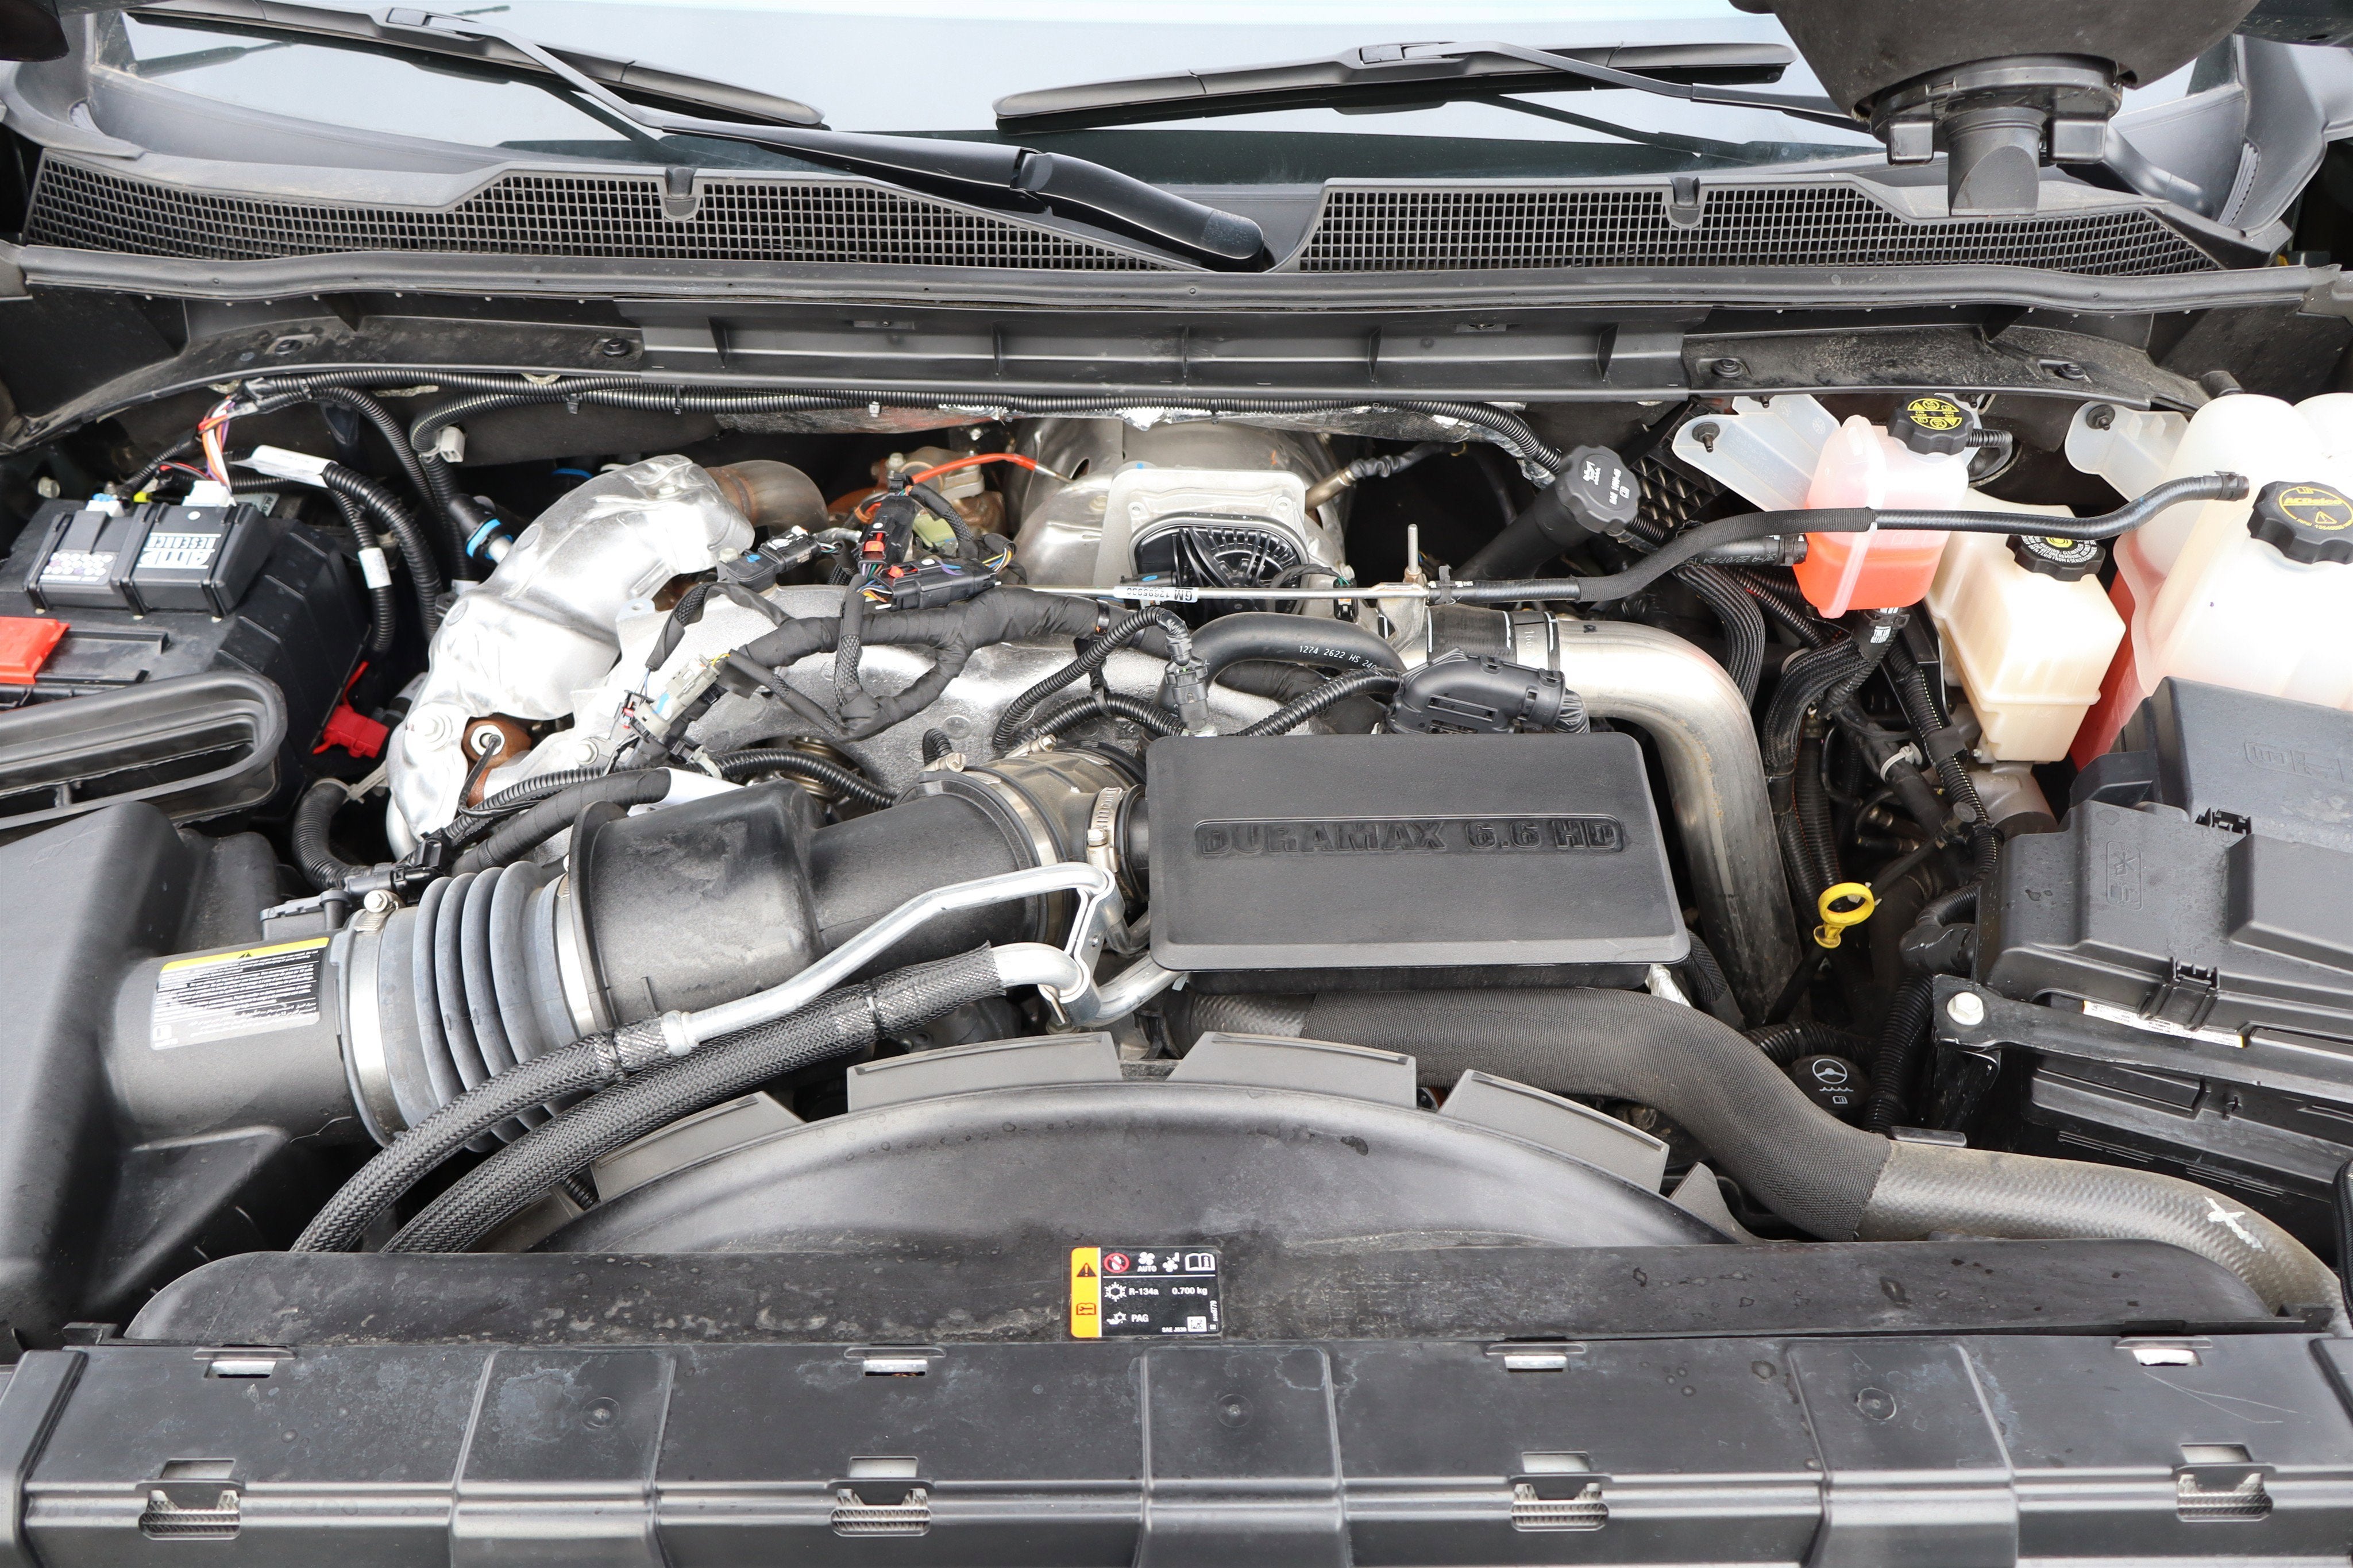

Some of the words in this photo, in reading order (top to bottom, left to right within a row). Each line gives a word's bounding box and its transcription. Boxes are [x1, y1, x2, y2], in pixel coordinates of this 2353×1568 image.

[145, 536, 217, 549] RESEARCH
[1703, 555, 1750, 563] 22/07/24
[2038, 551, 2053, 559] FLUID
[1174, 589, 1193, 601] GM
[1299, 645, 1320, 655] 1274
[1323, 648, 1346, 659] 2622
[1348, 654, 1361, 663] HS
[1201, 821, 1446, 855] DURAMAX
[1465, 820, 1542, 849] 6.6
[1553, 820, 1621, 849] HD
[1129, 1287, 1159, 1295] R-134a
[1172, 1287, 1195, 1295] 0.700
[1197, 1287, 1208, 1296] kg
[1131, 1314, 1149, 1323] PAG
